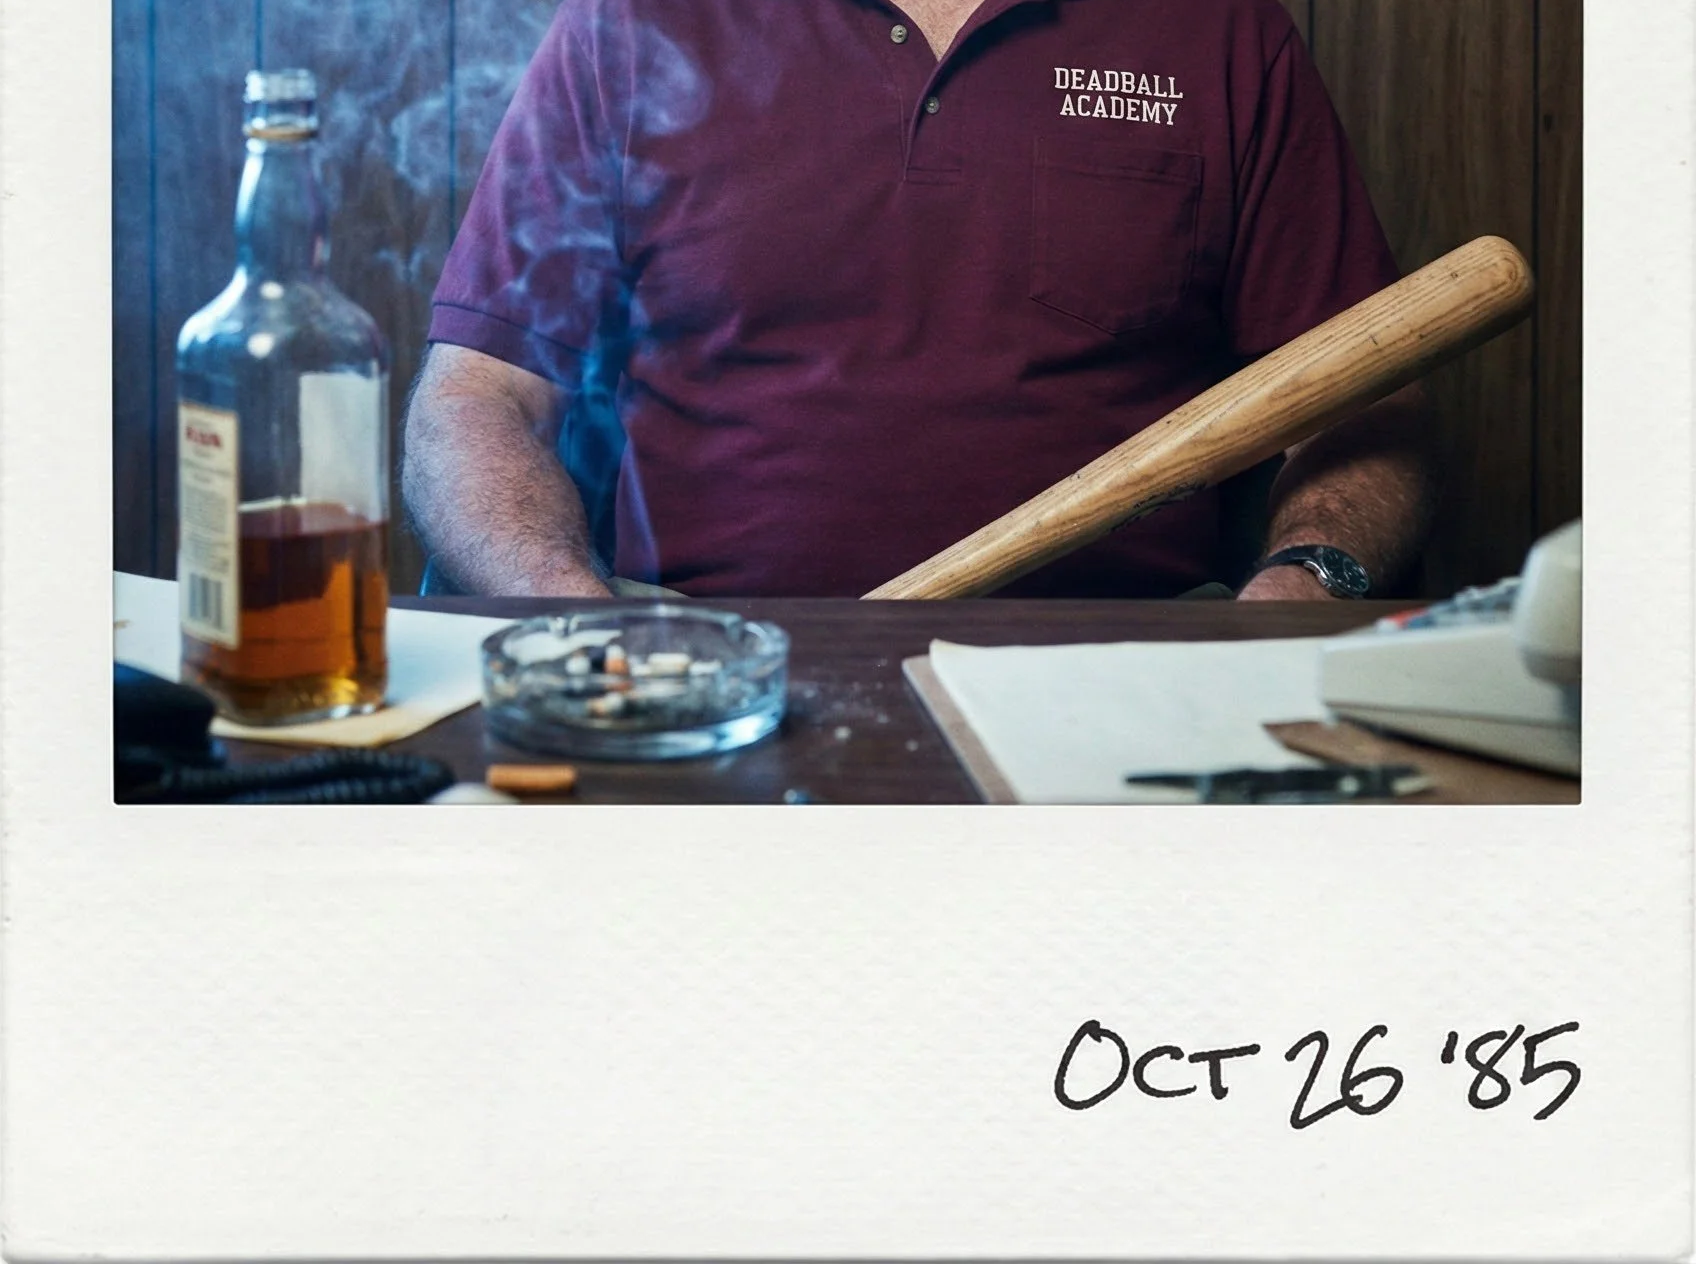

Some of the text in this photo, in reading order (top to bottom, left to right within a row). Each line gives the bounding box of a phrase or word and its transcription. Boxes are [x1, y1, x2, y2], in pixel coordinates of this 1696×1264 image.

[1054, 67, 1184, 99] DEADBALL
[1060, 93, 1178, 126] ACADEMY
[1285, 1025, 1404, 1130] 26
[1441, 1022, 1581, 1121] '85
